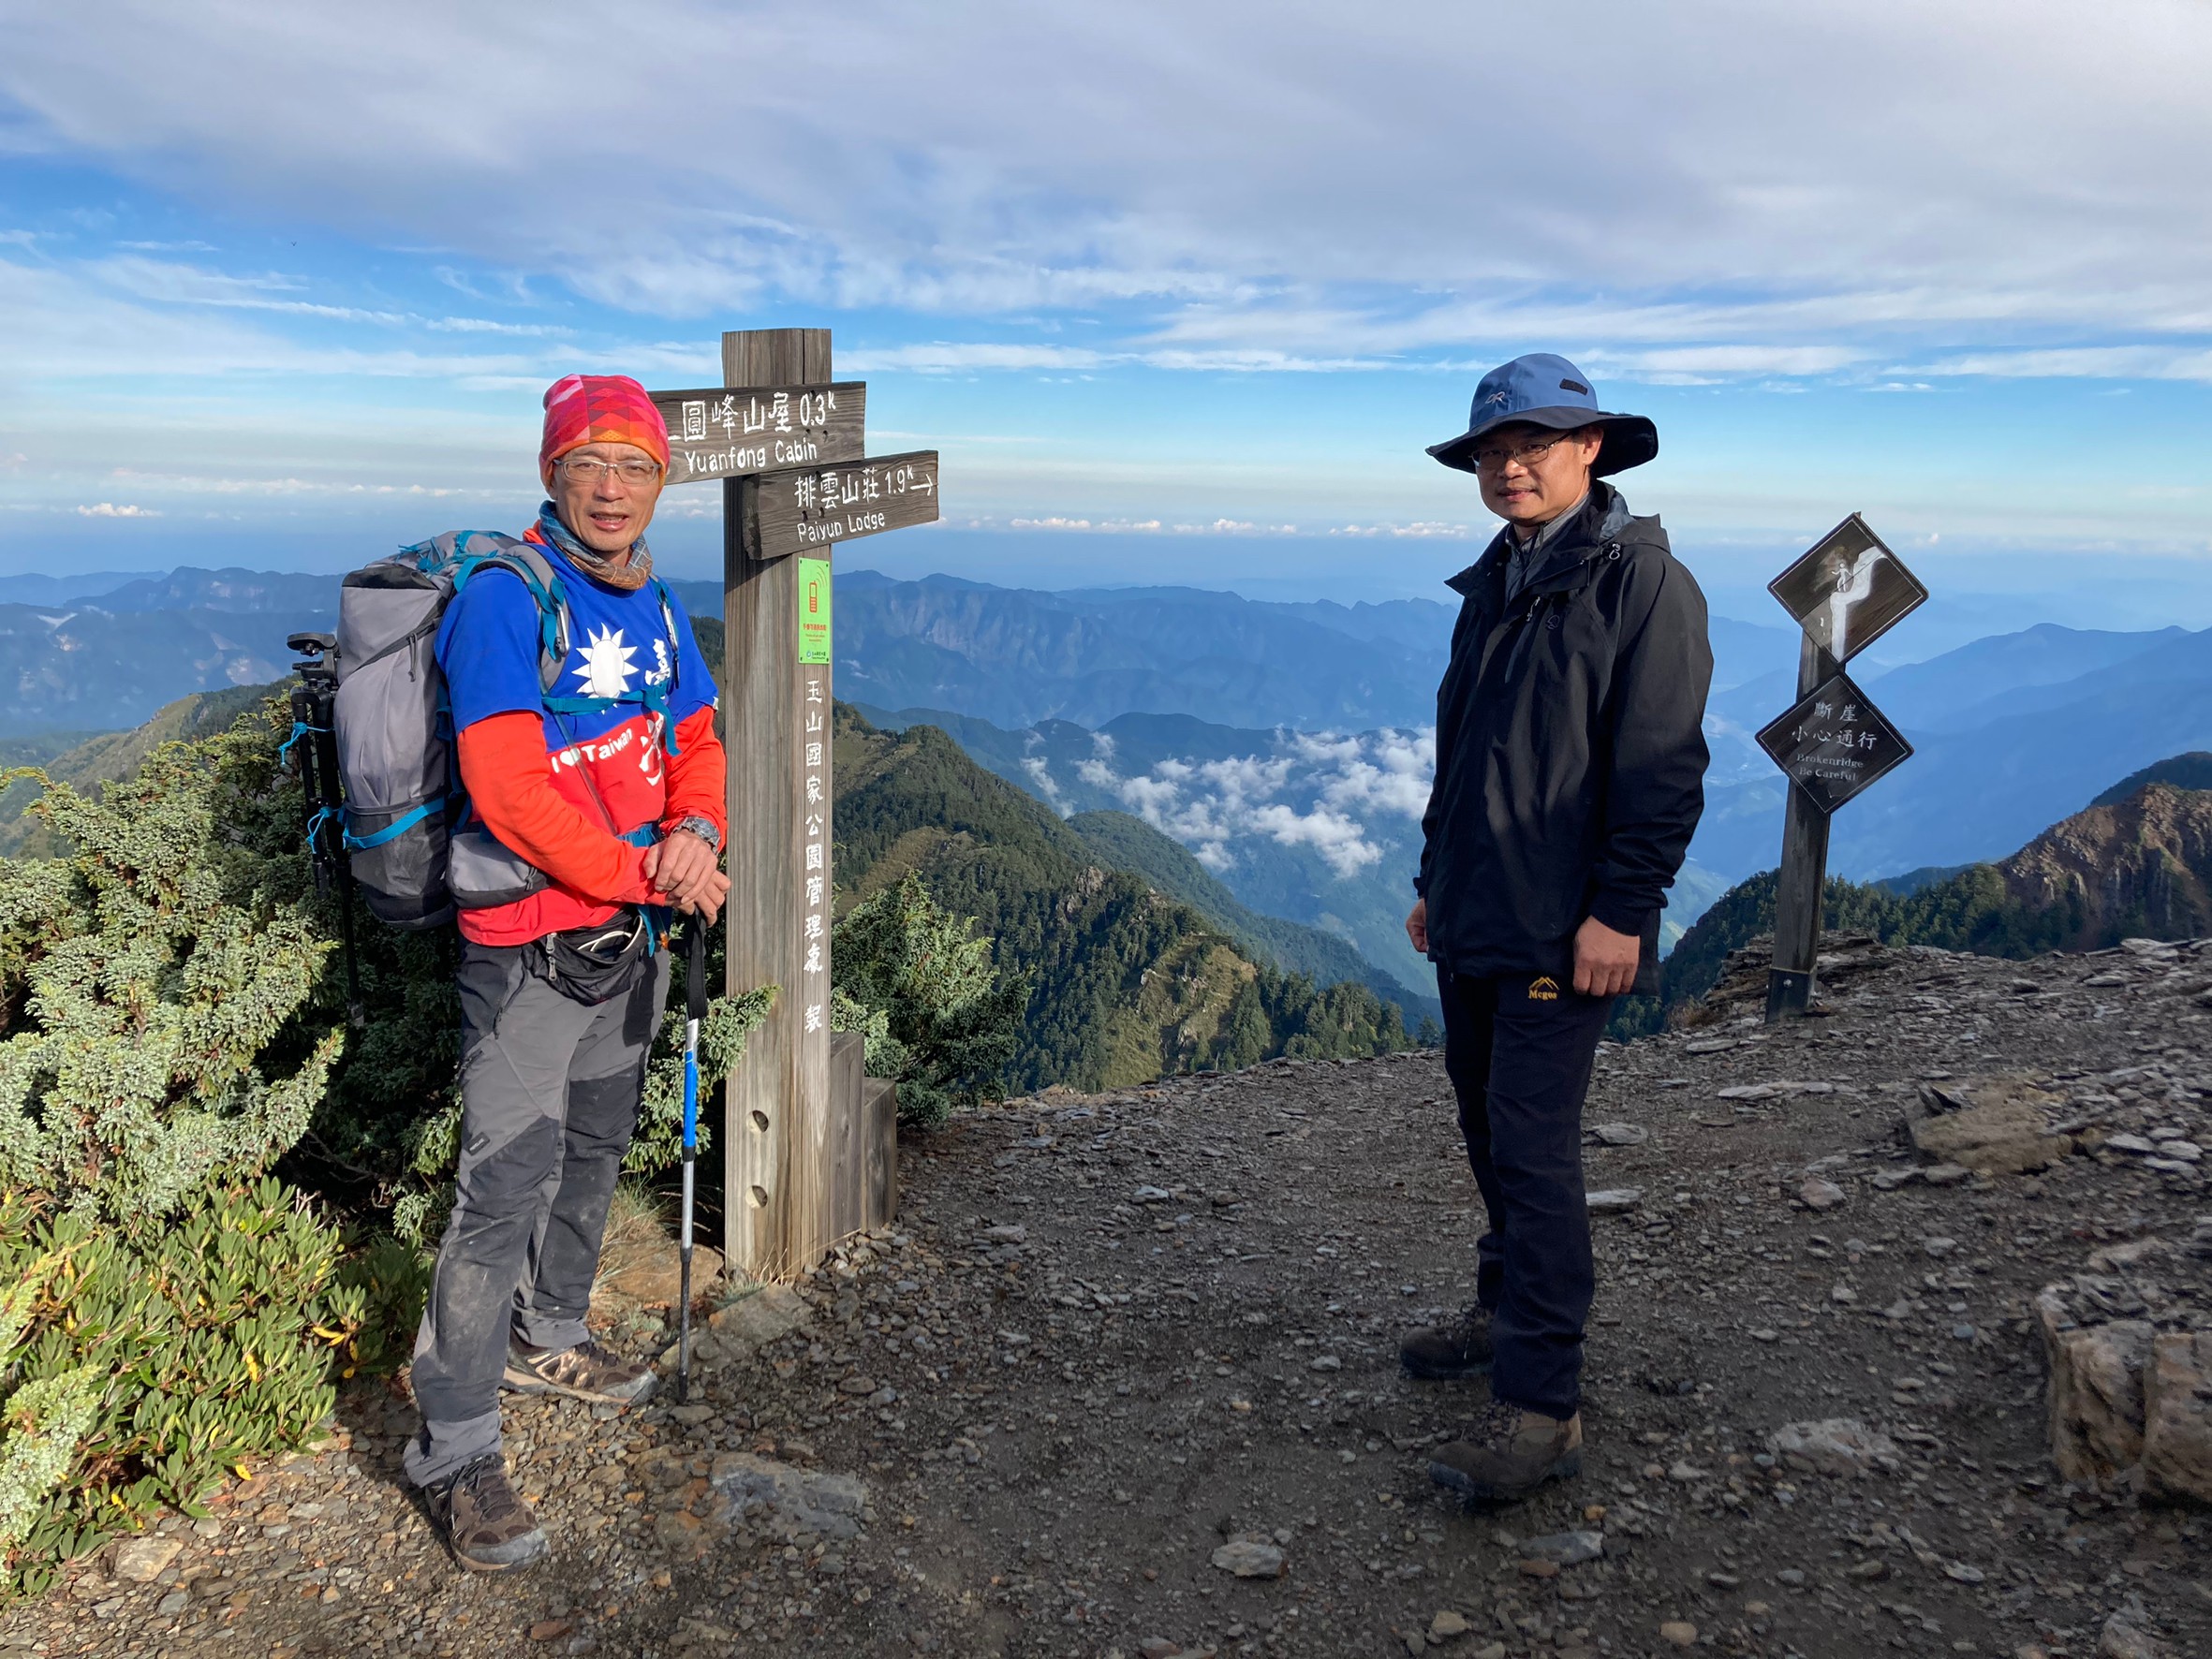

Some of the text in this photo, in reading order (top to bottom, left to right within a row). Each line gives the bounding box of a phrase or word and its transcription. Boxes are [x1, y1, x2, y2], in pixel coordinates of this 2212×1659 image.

[682, 391, 792, 441] 圓峰山屋
[685, 436, 818, 475] Yuanfong Cabin
[794, 467, 879, 510] 排雲山莊
[797, 511, 886, 543] Paiyun Lodge
[1813, 701, 1858, 722] 斷崖
[551, 727, 633, 774] I Taiwan
[1792, 725, 1878, 751] 小心通行
[1799, 767, 1857, 782] Be Careful
